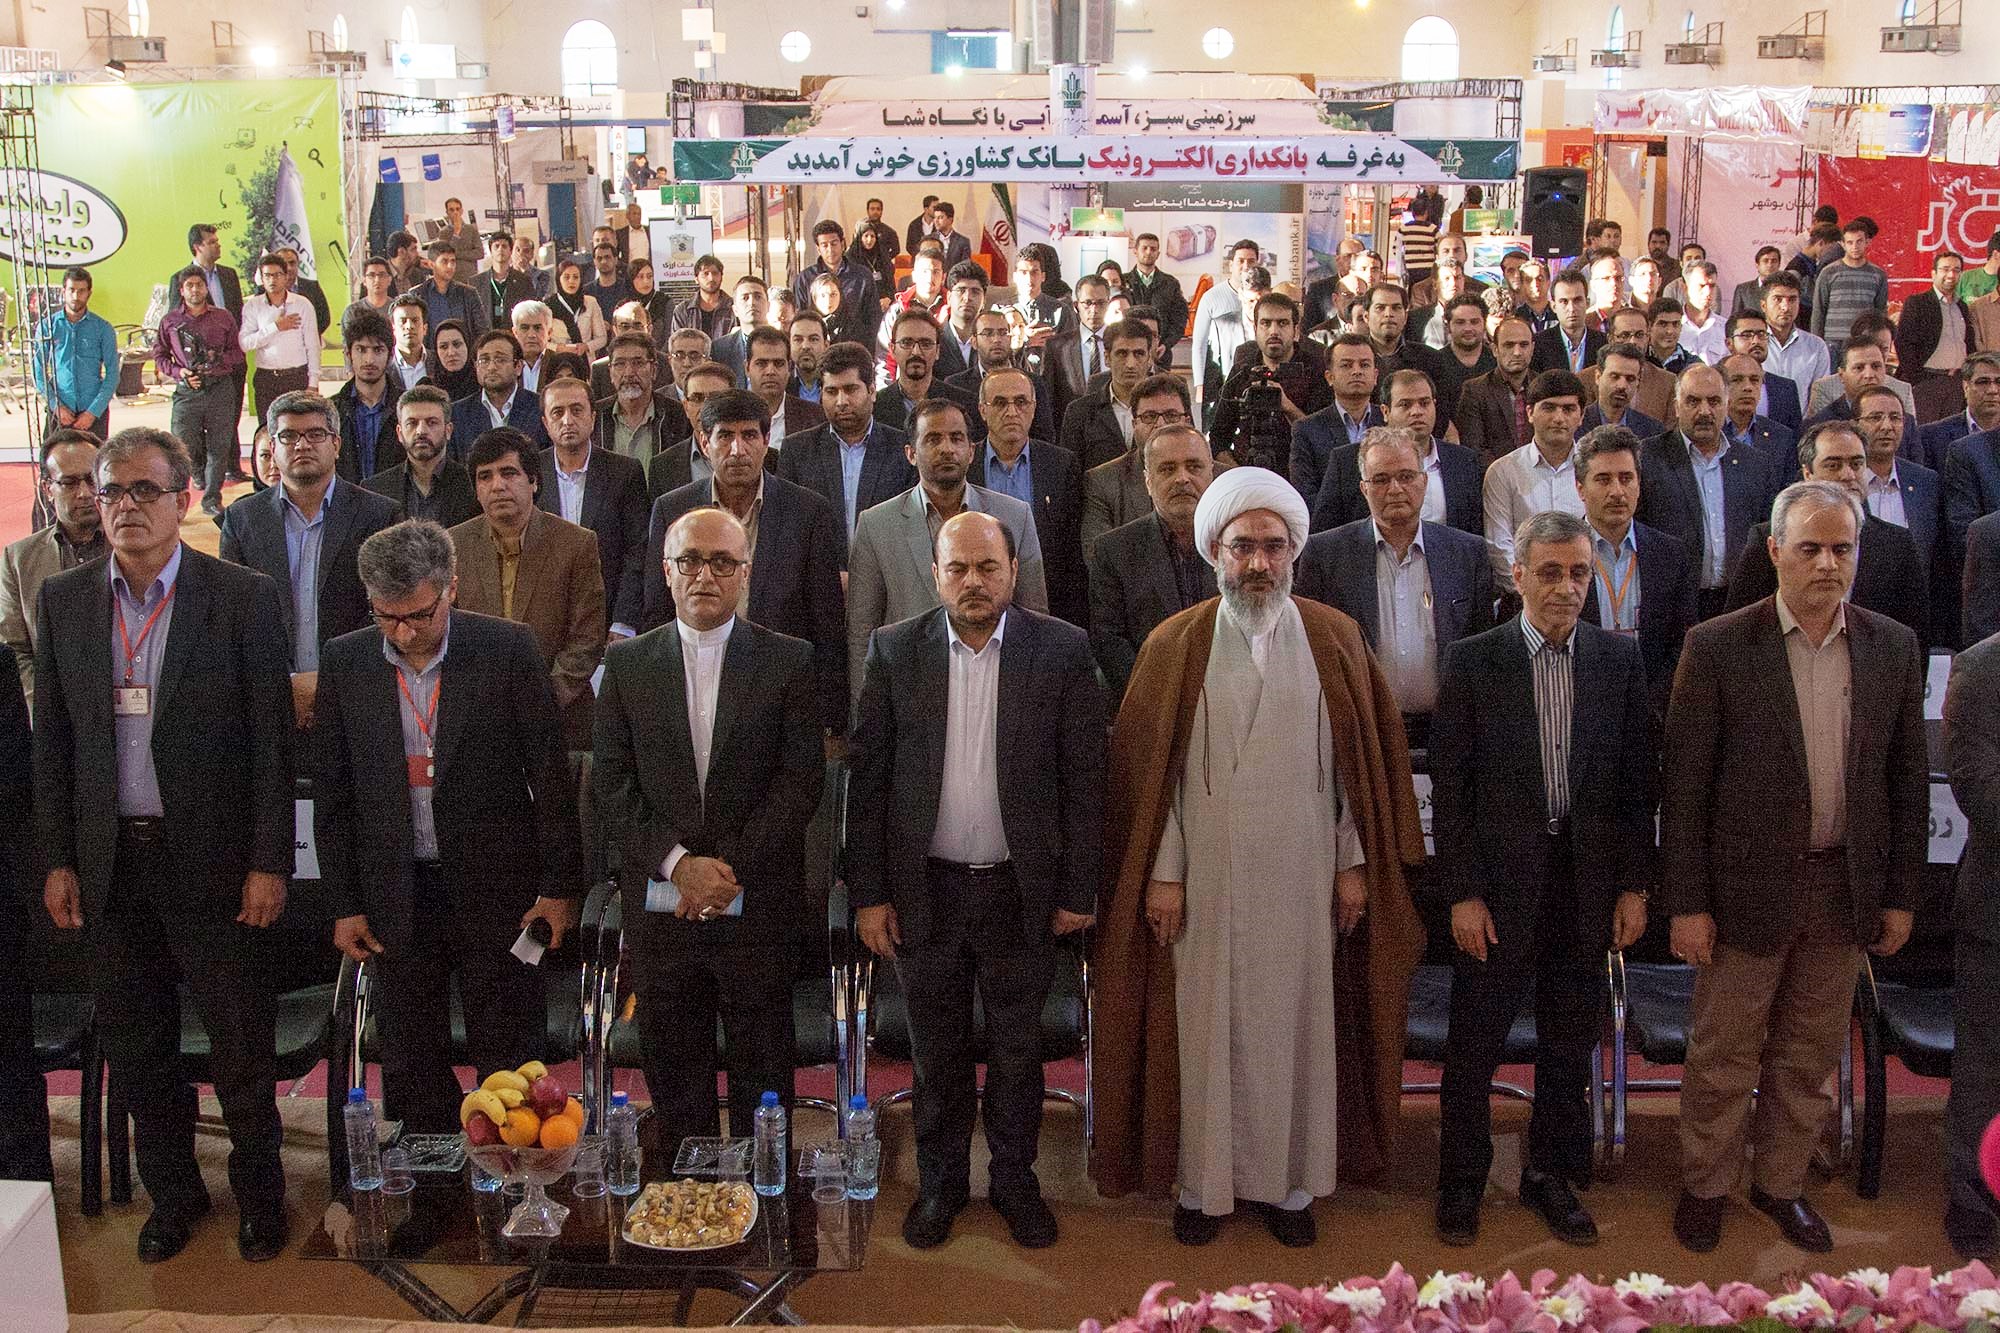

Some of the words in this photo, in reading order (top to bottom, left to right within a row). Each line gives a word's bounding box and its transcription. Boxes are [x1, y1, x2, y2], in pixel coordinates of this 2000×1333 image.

[882, 107, 926, 127] شما
[928, 107, 988, 126] نگاه
[993, 107, 1005, 130] با
[1096, 104, 1132, 126] آسم
[1185, 109, 1256, 131] سرزمینی
[787, 143, 854, 176] آمدید
[855, 146, 915, 177] خوش
[917, 144, 1015, 177] کشاورزی
[1016, 144, 1086, 176] بانک
[1087, 144, 1214, 177] الکترونیک
[1215, 144, 1308, 177] بانکداری
[1316, 143, 1384, 177] غرفه
[1385, 151, 1405, 175] به
[1132, 197, 1187, 209] اینجاست
[1187, 197, 1206, 208] شما
[1206, 198, 1250, 210] اندوخته
[1749, 197, 1784, 211] بوشهر
